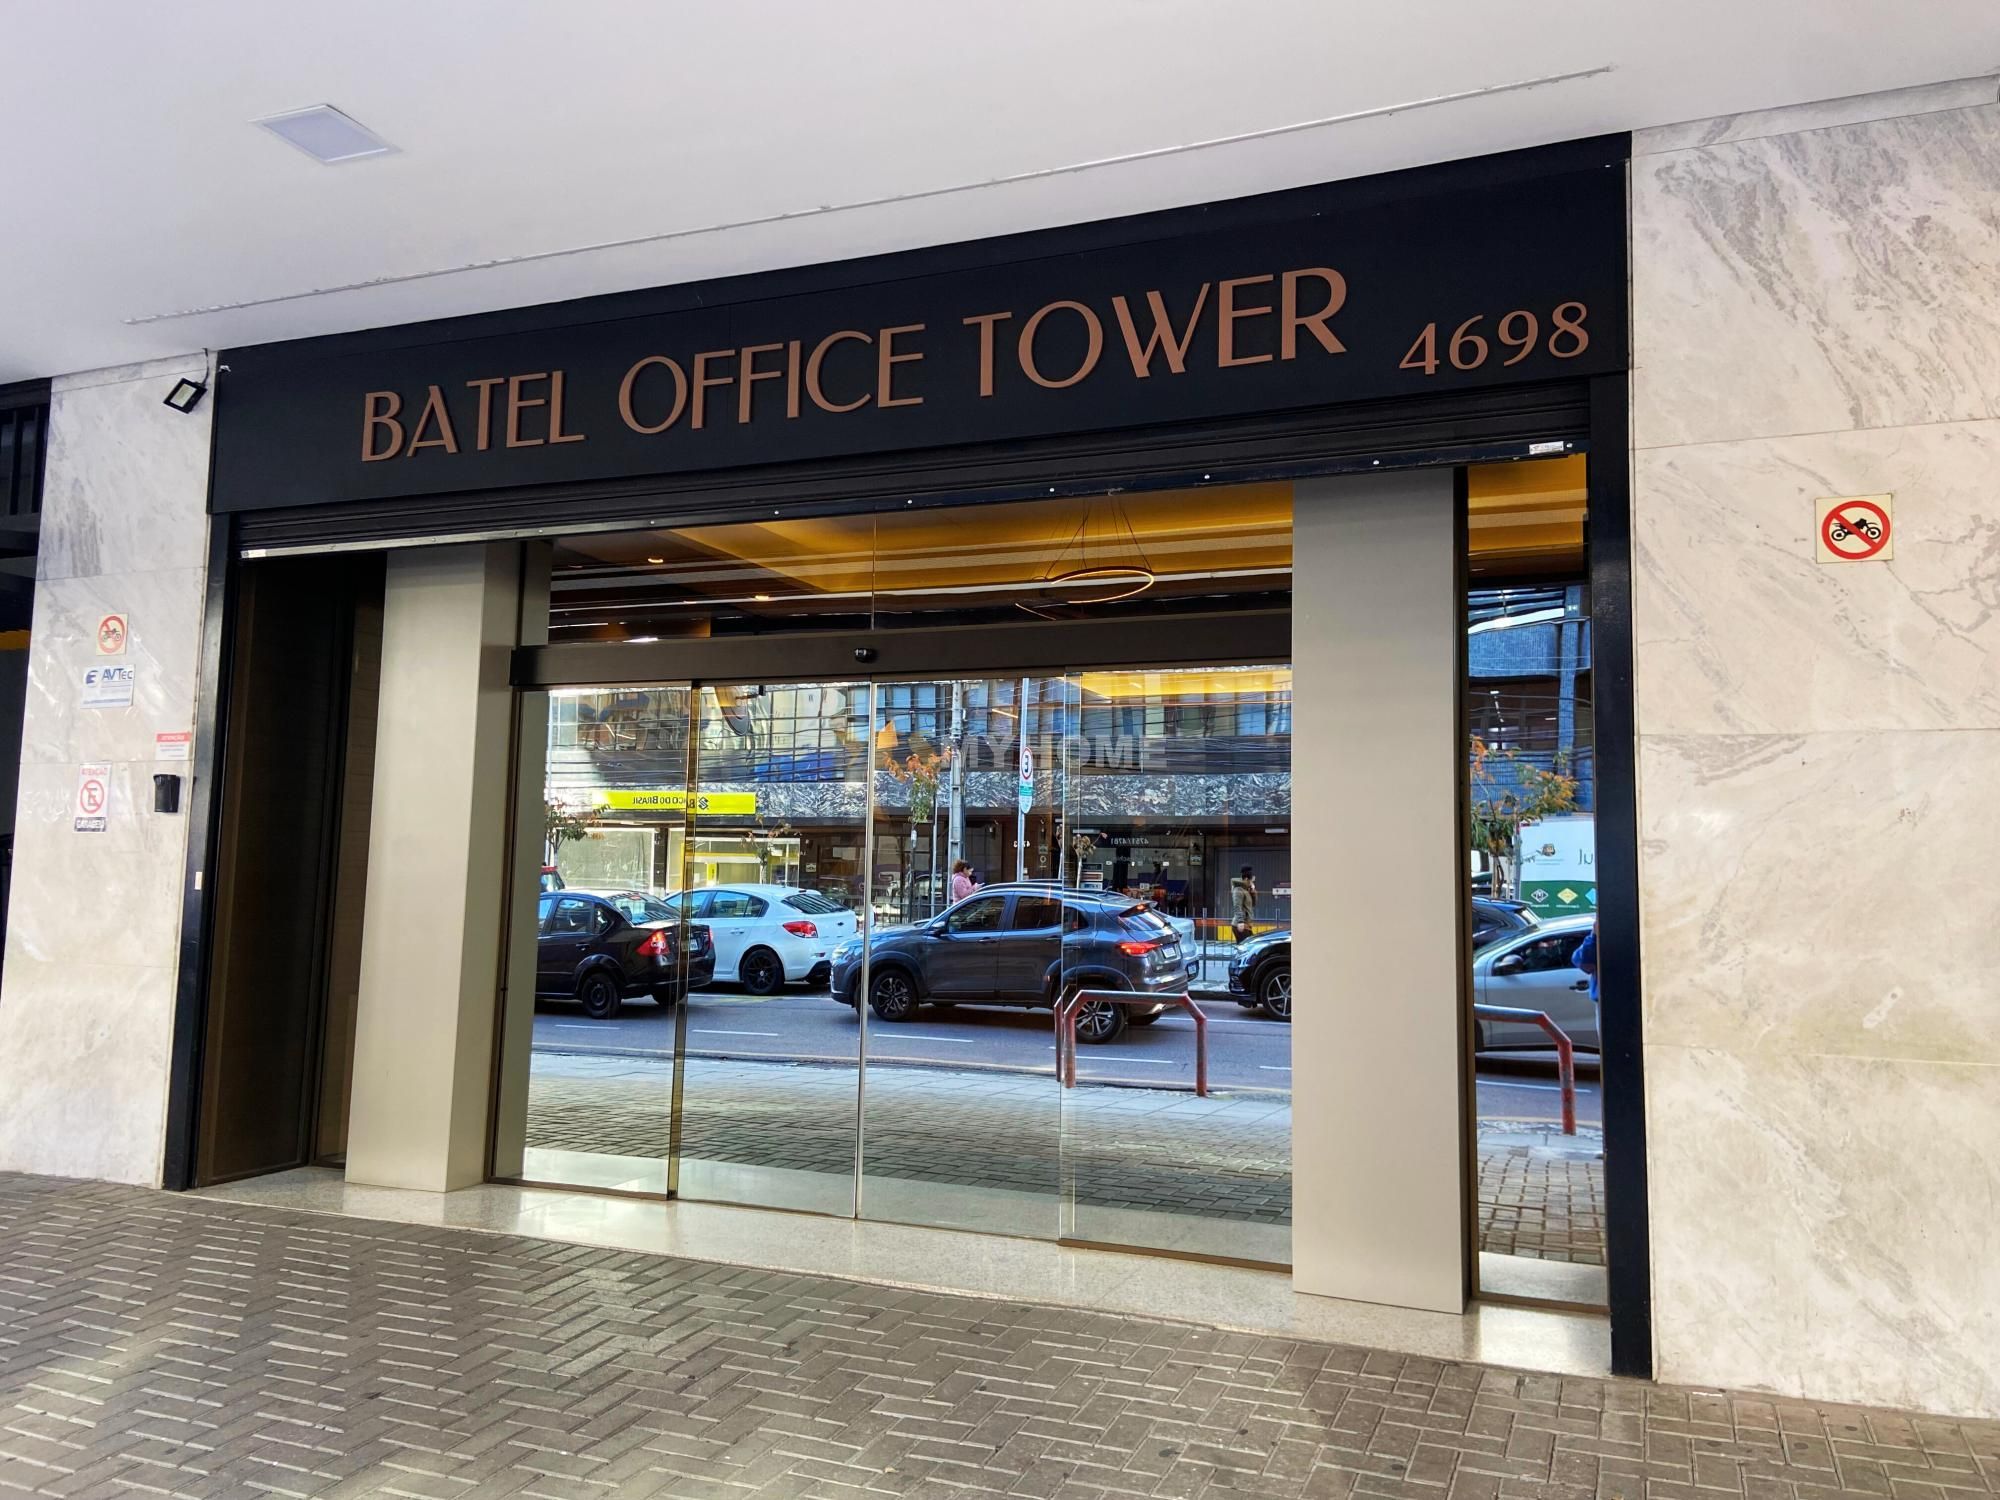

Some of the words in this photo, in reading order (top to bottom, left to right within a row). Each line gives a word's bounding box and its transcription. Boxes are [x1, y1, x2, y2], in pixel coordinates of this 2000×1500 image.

[361, 370, 586, 462] BATEL
[618, 323, 926, 434] OFFICE
[963, 267, 1348, 397] TOWER
[1399, 301, 1590, 375] 4698
